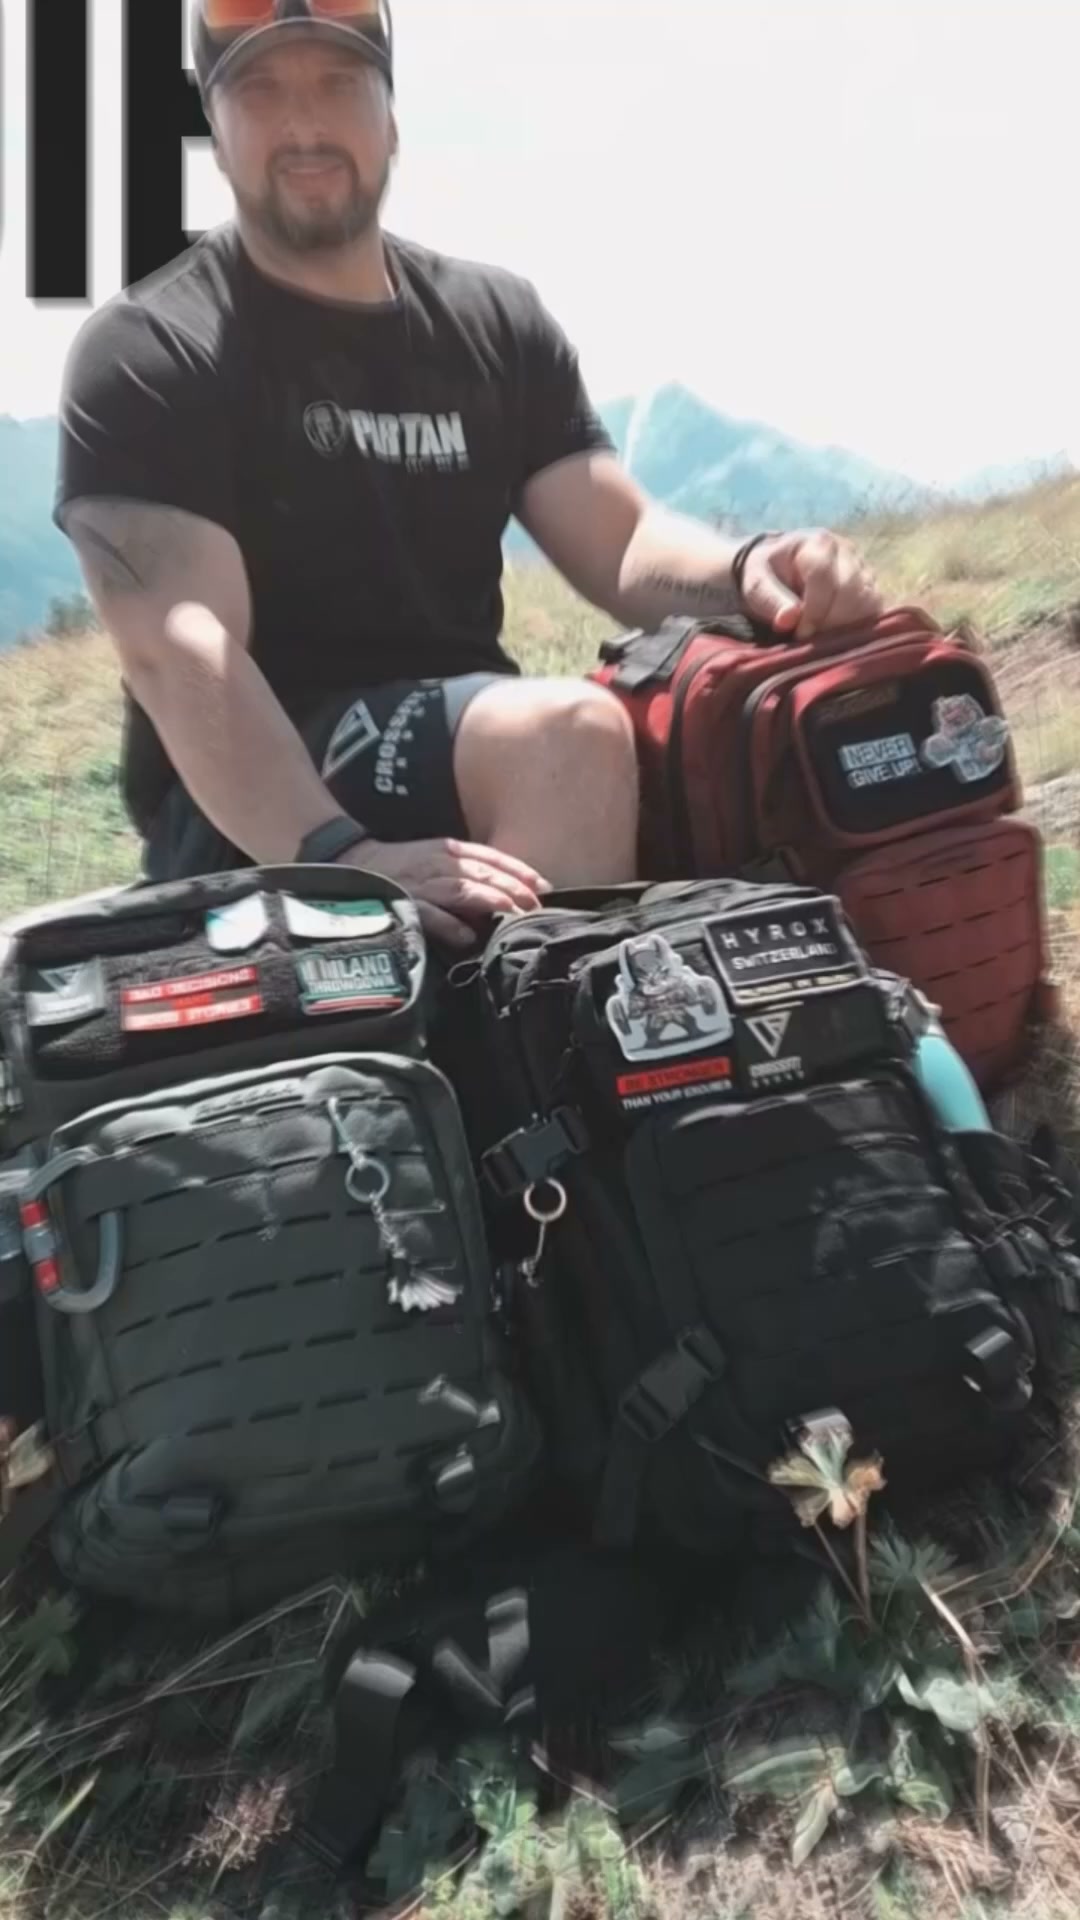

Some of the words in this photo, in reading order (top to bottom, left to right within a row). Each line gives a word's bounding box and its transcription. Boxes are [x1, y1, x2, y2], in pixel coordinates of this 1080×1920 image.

[846, 737, 911, 767] NEVER
[850, 765, 891, 787] GIVE
[720, 917, 829, 949] HYROX
[731, 942, 838, 970] SWITZERLAND
[622, 1096, 652, 1111] THAN
[653, 1088, 683, 1104] YOUR
